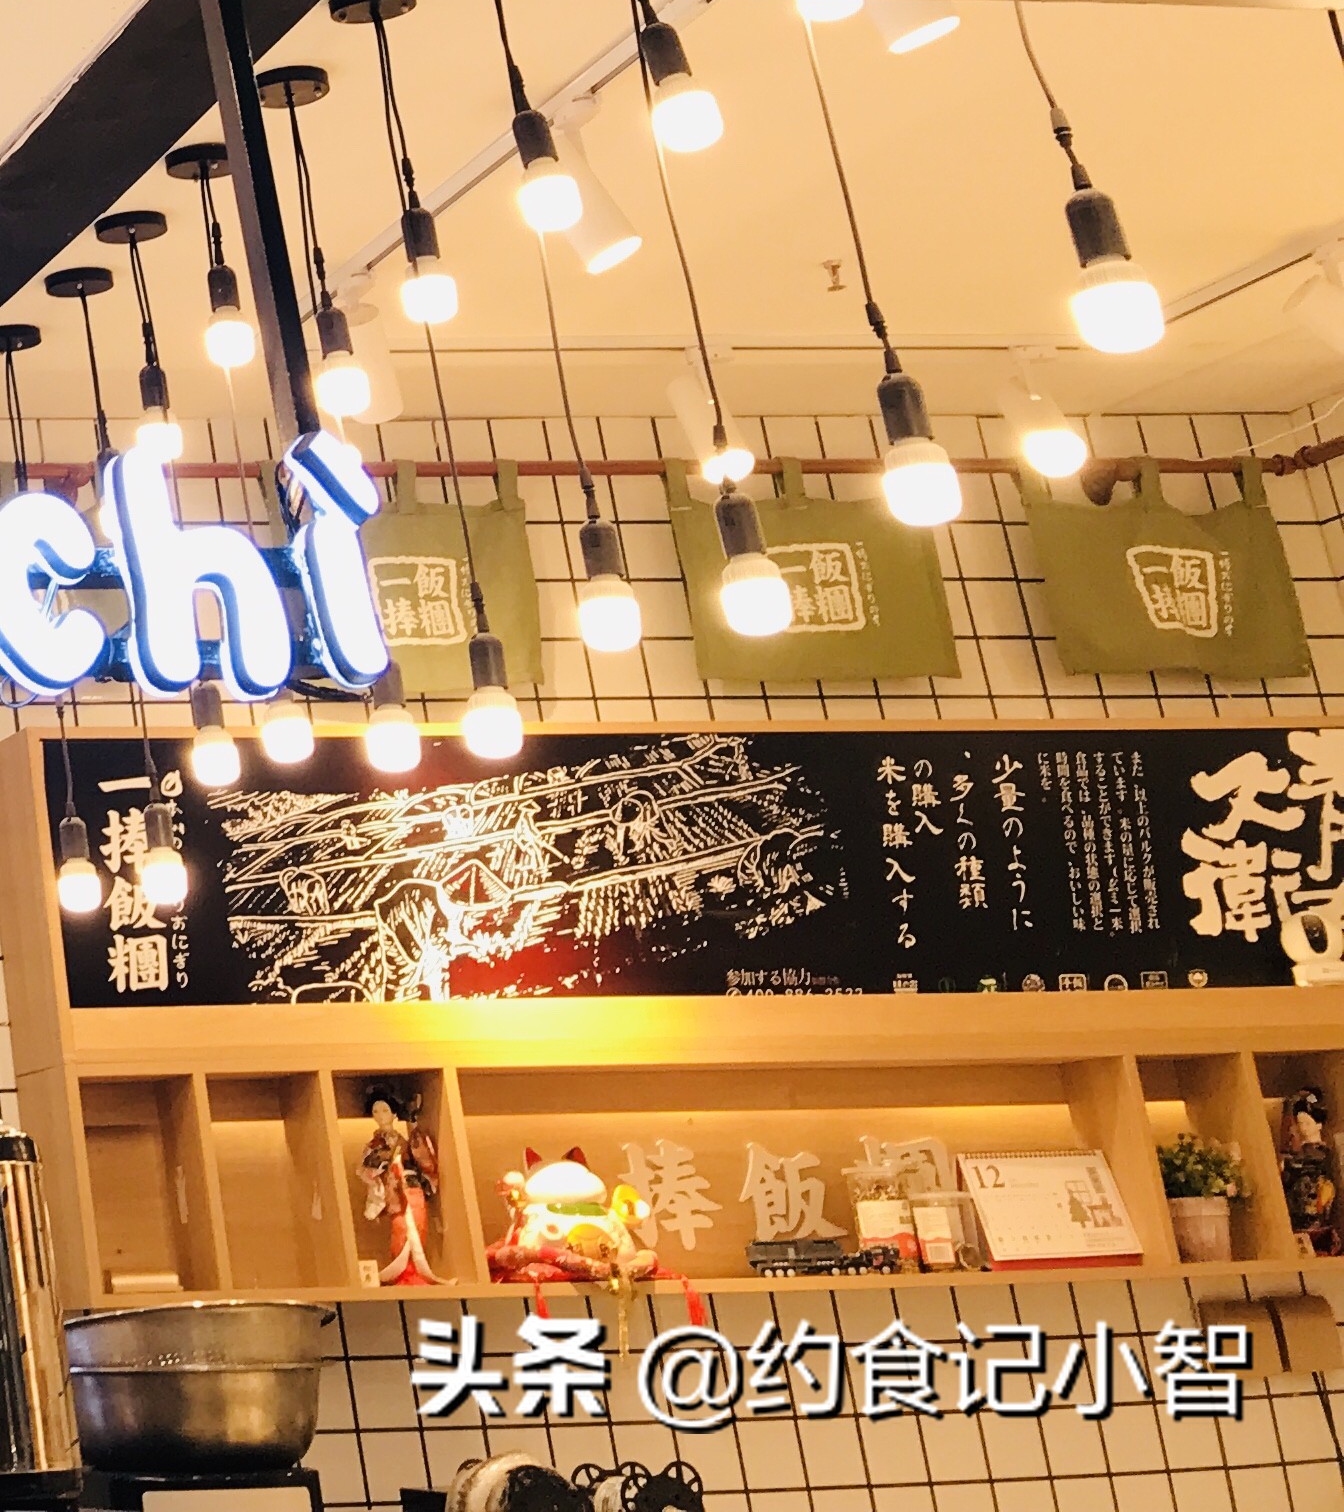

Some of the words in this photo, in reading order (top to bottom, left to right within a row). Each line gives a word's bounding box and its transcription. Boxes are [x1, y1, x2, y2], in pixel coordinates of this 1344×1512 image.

[991, 754, 1033, 930] 少量のように
[971, 1164, 1006, 1189] 12
